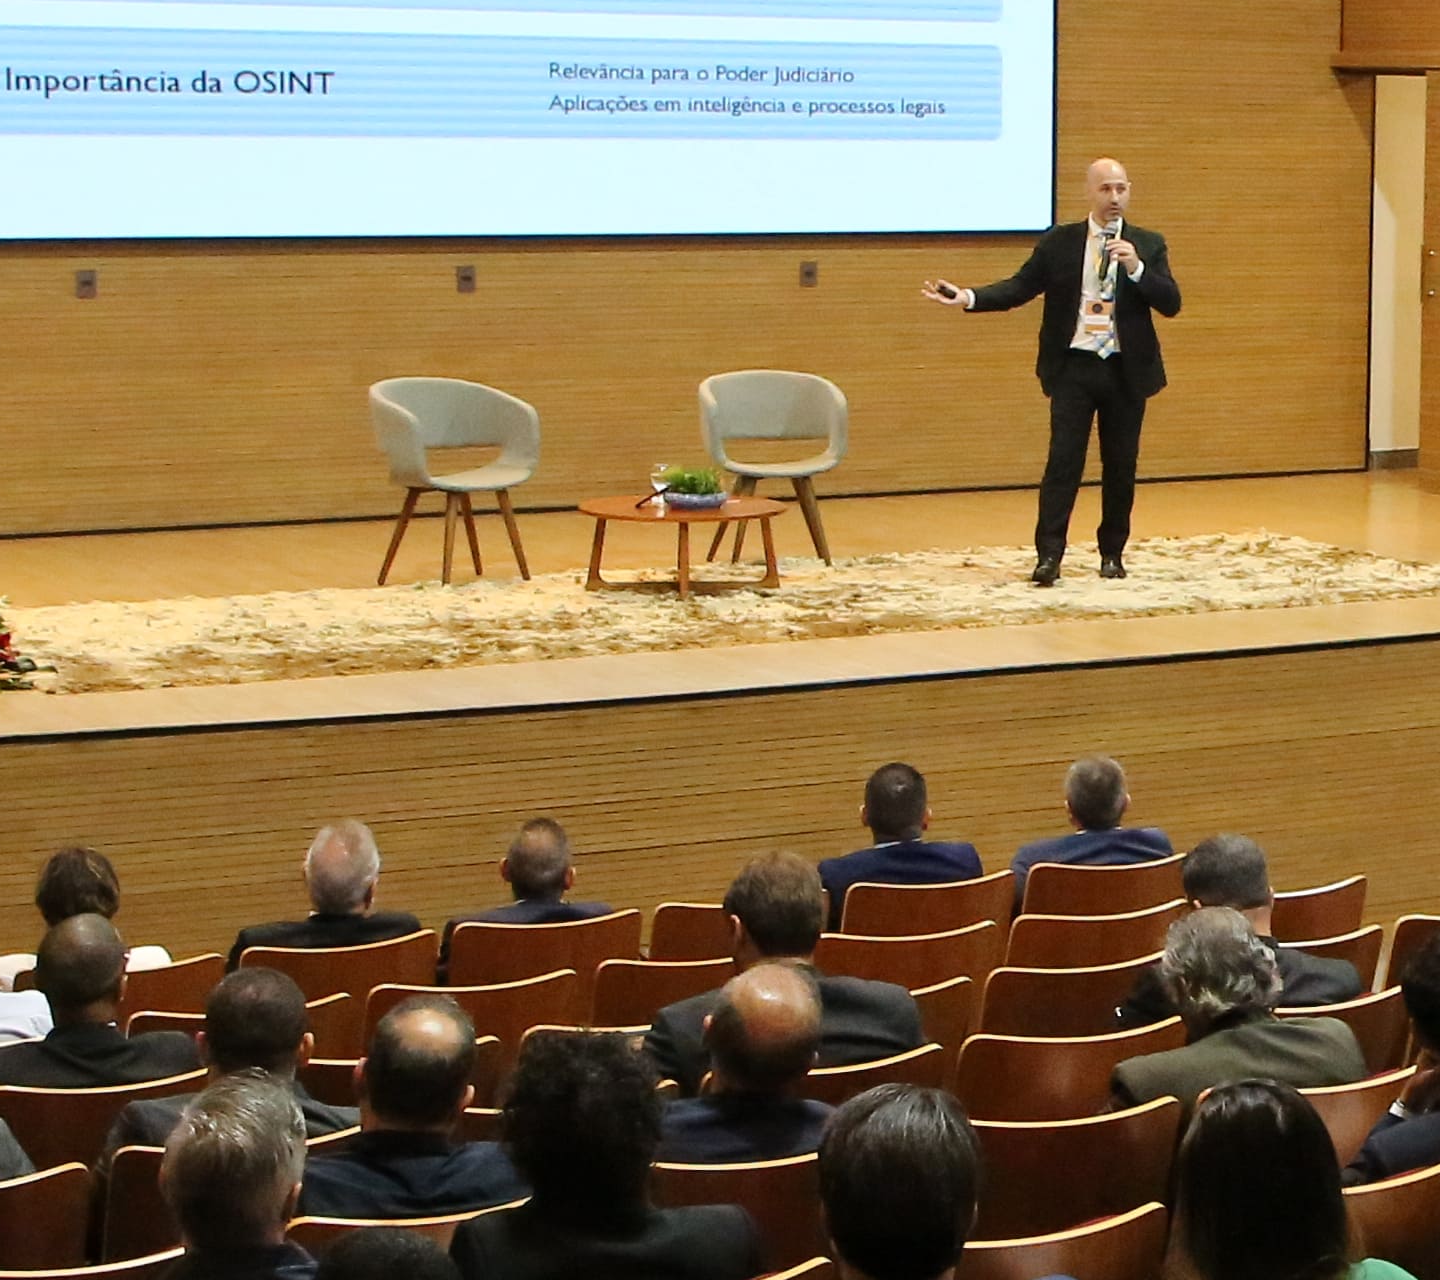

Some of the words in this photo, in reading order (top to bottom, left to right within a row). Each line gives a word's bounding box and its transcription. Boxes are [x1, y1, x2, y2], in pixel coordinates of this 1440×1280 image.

[6, 67, 181, 99] Importância
[191, 70, 222, 93] da
[233, 70, 335, 95] OSINT
[548, 62, 644, 80] Relevância
[651, 68, 689, 84] para
[697, 69, 709, 81] o
[715, 64, 768, 82] Poder
[773, 66, 855, 87] Judiciário
[548, 94, 648, 115] Aplicações
[654, 99, 681, 112] em
[688, 96, 786, 117] inteligência
[792, 101, 802, 113] e
[808, 100, 896, 117] processos
[900, 97, 946, 118] legais
